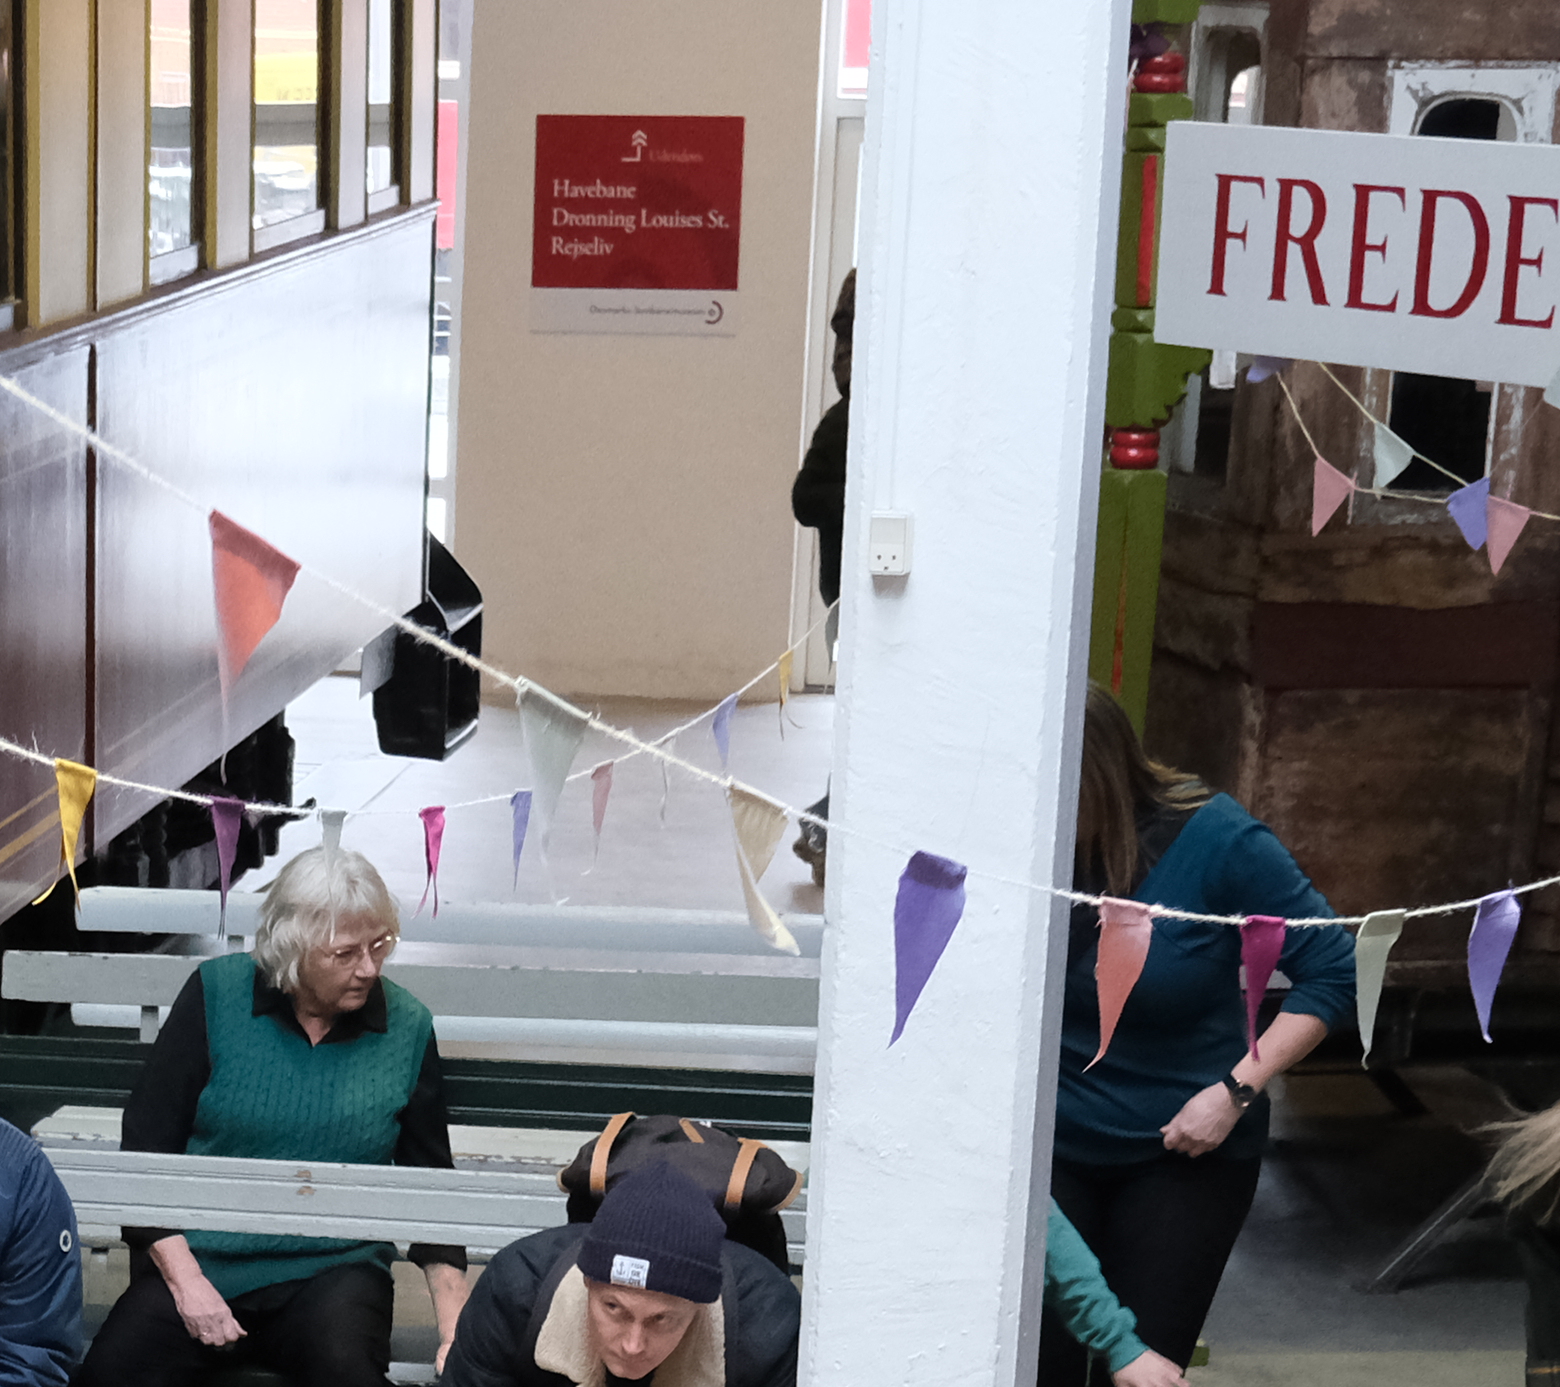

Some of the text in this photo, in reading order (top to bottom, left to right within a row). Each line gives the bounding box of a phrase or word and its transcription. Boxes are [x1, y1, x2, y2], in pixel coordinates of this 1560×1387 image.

[551, 178, 637, 199] Havebane
[551, 207, 730, 234] Dronning Louises St.
[551, 236, 615, 260] Rejseliv
